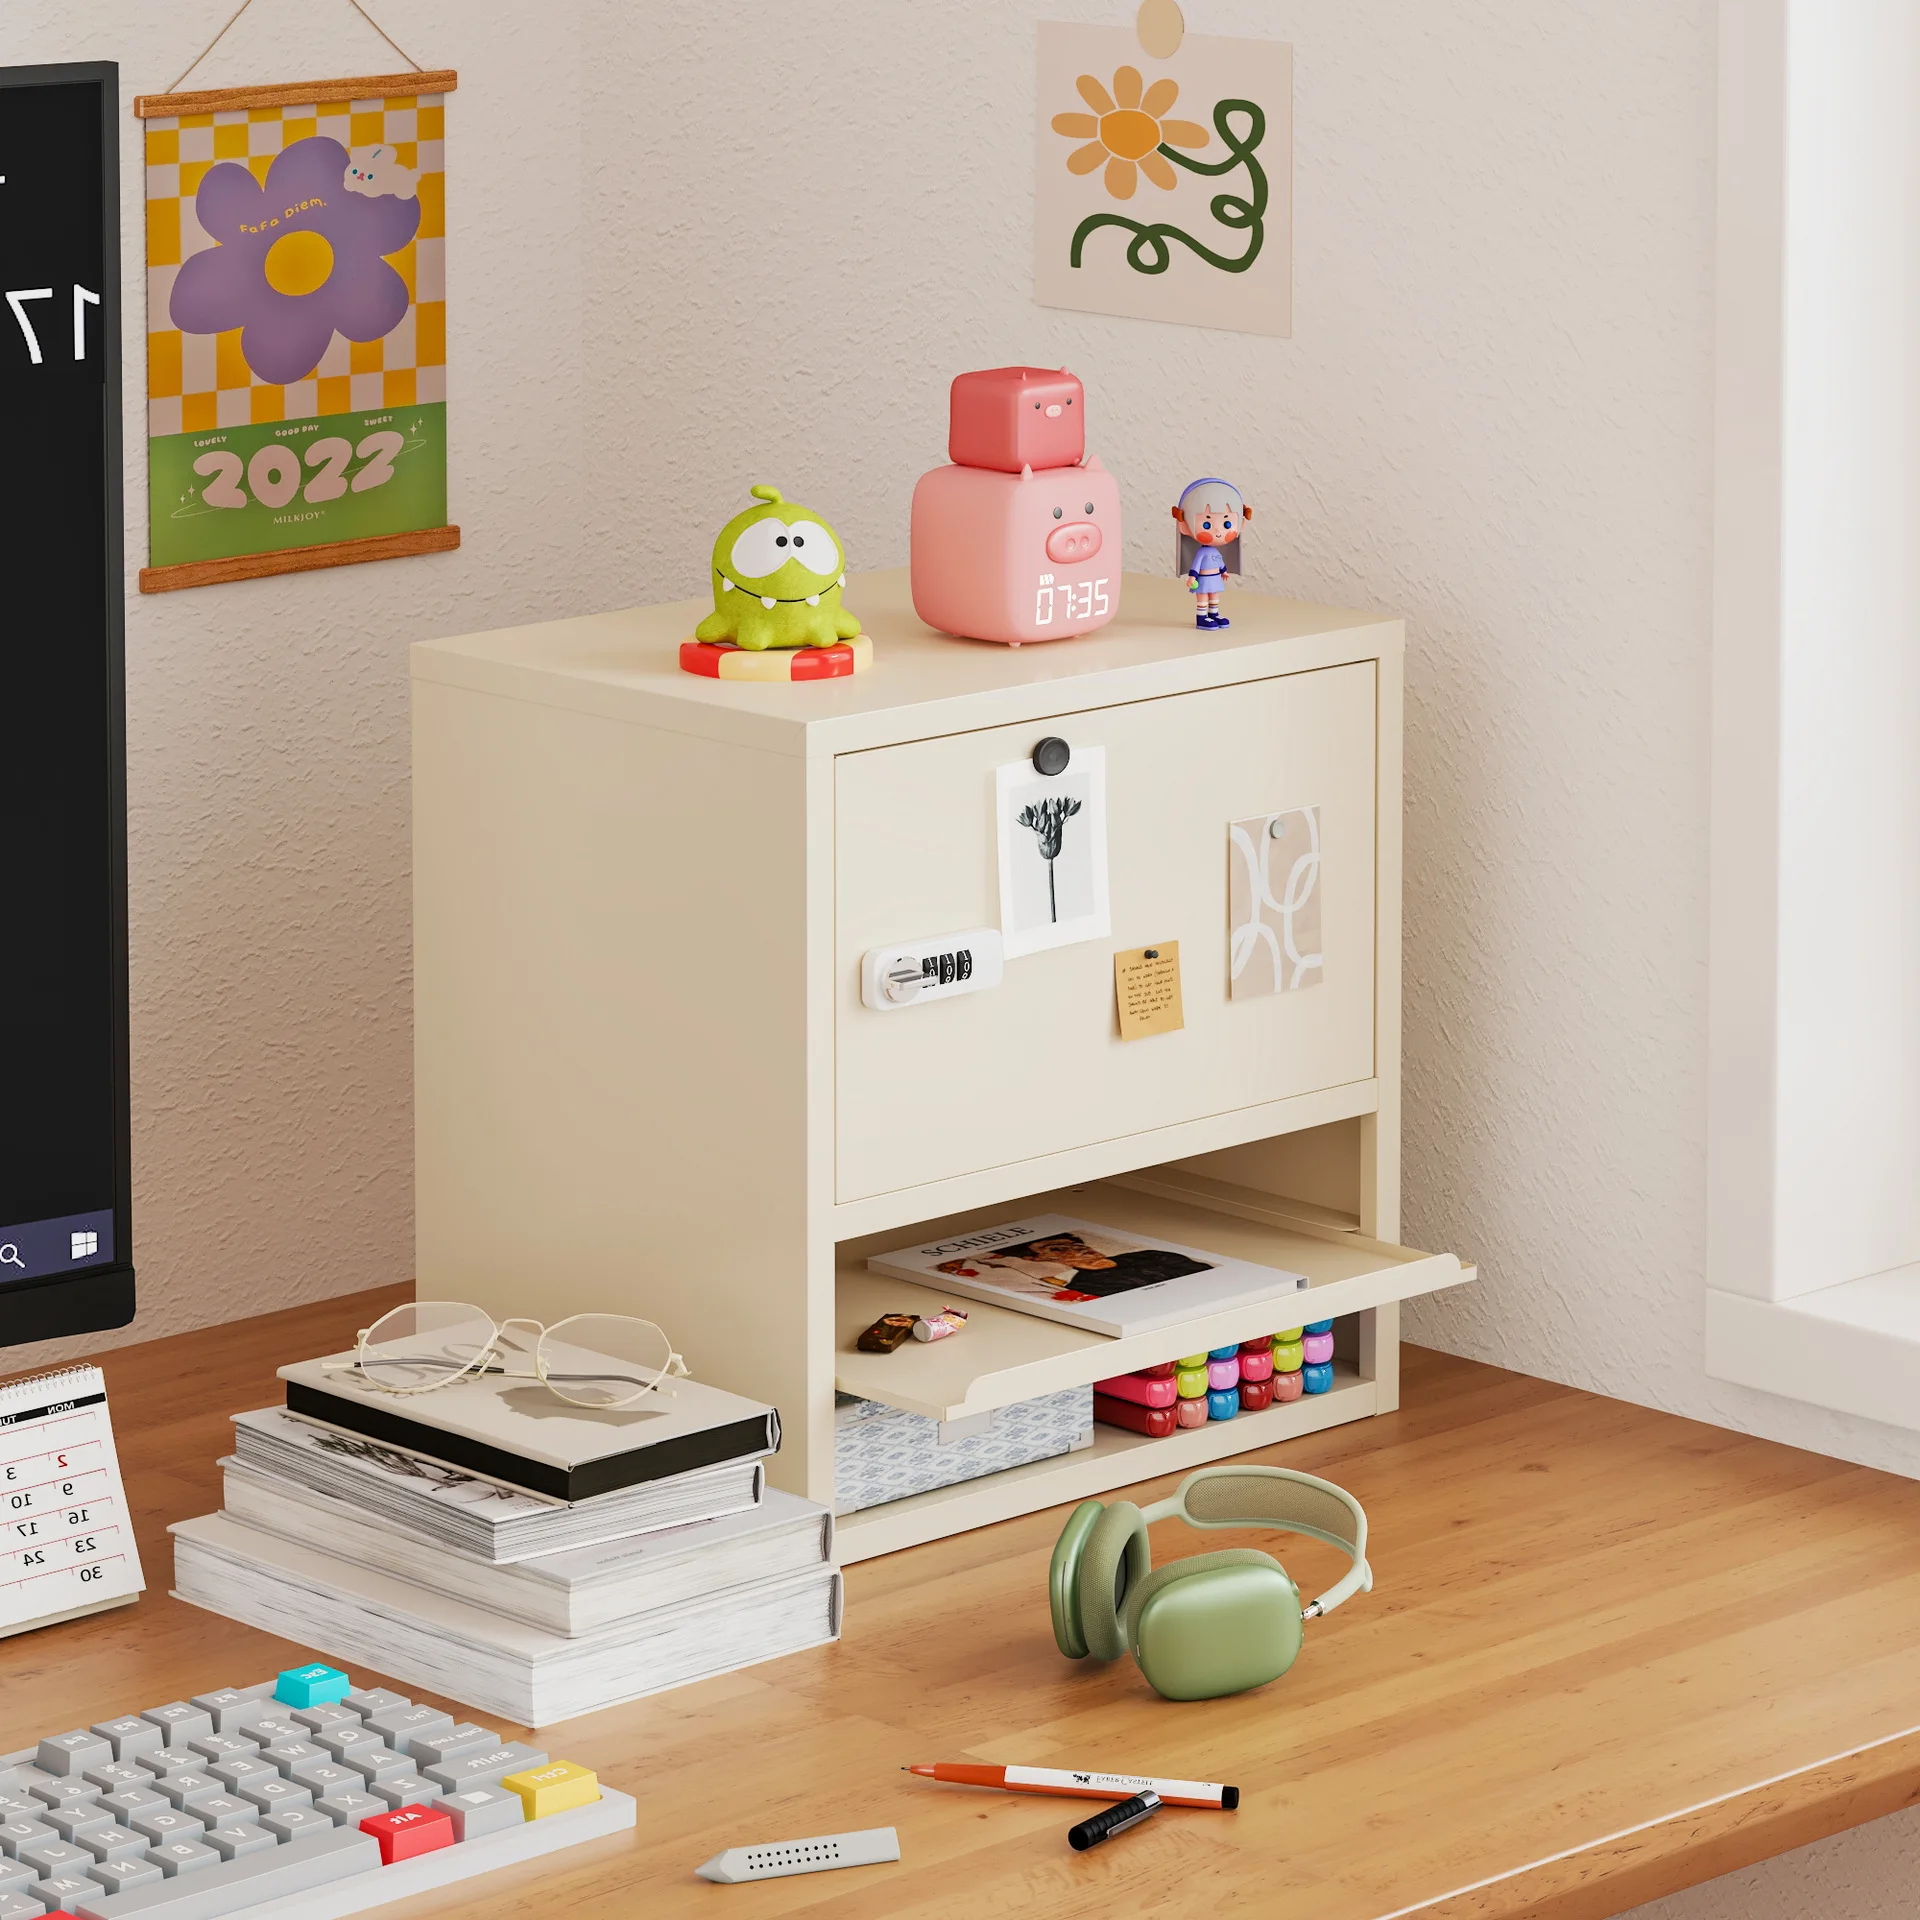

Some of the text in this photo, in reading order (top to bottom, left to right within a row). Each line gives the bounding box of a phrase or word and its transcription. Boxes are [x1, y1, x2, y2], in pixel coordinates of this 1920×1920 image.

[275, 424, 319, 438] GOOD DAY
[364, 415, 394, 427] SWEET
[194, 435, 227, 448] LOVELY
[193, 430, 405, 509] 2022
[1036, 578, 1109, 626] 07:35
[921, 1226, 1035, 1257] SCHIELE
